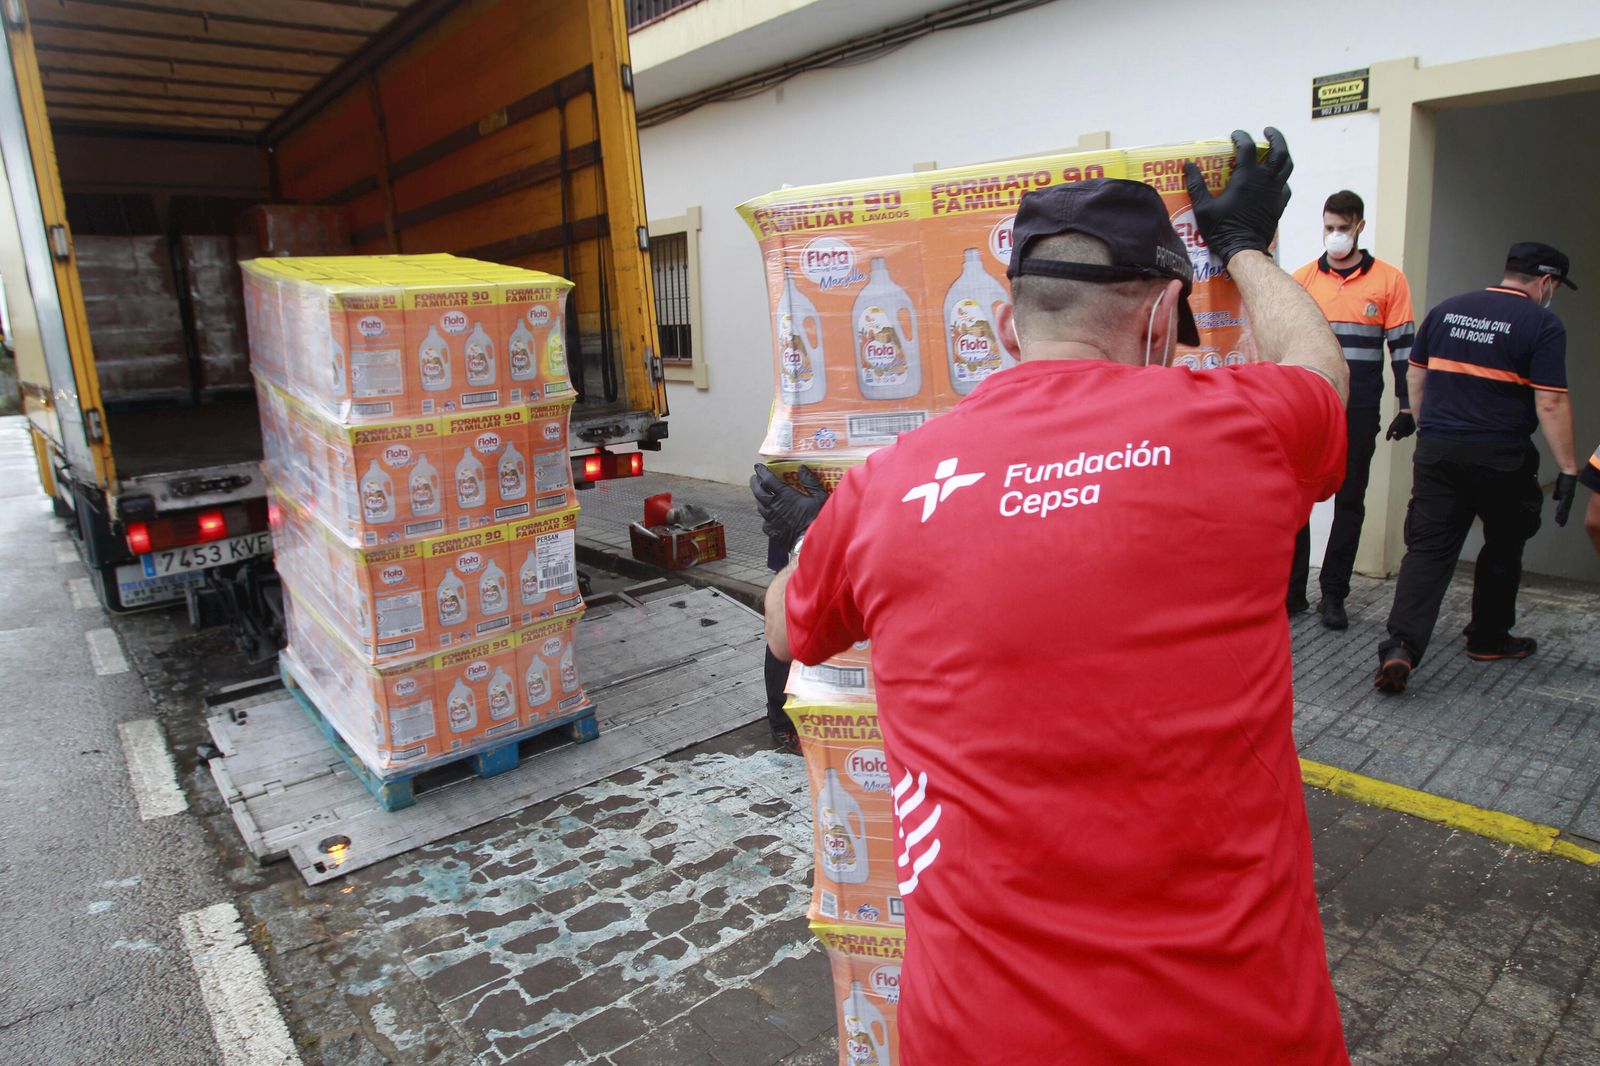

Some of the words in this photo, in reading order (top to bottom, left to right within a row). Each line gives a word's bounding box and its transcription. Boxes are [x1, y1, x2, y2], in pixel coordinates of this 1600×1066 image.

[1321, 83, 1360, 96] STANLEY
[931, 170, 1051, 199] FORMATO
[753, 196, 854, 223] FORMATO
[864, 190, 902, 212] 90
[932, 188, 1045, 214] FAMILI
[759, 211, 855, 237] FAMILIAR
[862, 210, 910, 222] LAVADOS
[1175, 223, 1208, 248] Flo
[807, 247, 849, 267] Flota
[415, 292, 468, 301] FORMATO
[472, 291, 489, 300] 90
[505, 287, 551, 296] FORMATO
[505, 294, 551, 303] FAMILIAR
[382, 295, 396, 305] 90
[415, 299, 468, 308] FAMILIAR
[444, 316, 465, 325] Flota
[530, 310, 548, 318] Flota
[361, 320, 382, 329] Flota
[1443, 313, 1489, 330] PROTECCIÓN
[1491, 321, 1512, 334] CIVIL
[1450, 327, 1467, 340] SAN
[1466, 328, 1495, 344] ROQUE
[868, 345, 894, 357] Flota
[960, 339, 988, 351] Flota
[450, 415, 501, 427] FORMATO
[504, 412, 521, 421] 90
[355, 426, 412, 437] FORMATO
[415, 423, 434, 433] 90
[451, 423, 501, 433] FAMILIAR
[355, 433, 412, 444] FAMILIAR
[478, 437, 498, 446] Flota
[386, 449, 408, 458] Flota
[1003, 440, 1171, 488] Fundación
[999, 484, 1101, 518] Cepsa
[515, 517, 560, 532] FORMATO
[562, 514, 576, 523] 90
[516, 524, 560, 539] FAMILIAR
[537, 533, 559, 543] PERSAN
[432, 534, 482, 550] FORMATO
[485, 530, 501, 540] 90
[162, 545, 222, 572] 7453
[229, 534, 268, 559] KVF
[432, 541, 482, 556] FAMILIAR
[459, 555, 479, 566] Flota
[383, 569, 403, 578] Flota
[441, 645, 490, 661] FORMATO
[493, 639, 509, 649] 90
[441, 651, 489, 667] FAMILIAR
[468, 665, 488, 675] Flota
[396, 681, 414, 690] Flota
[798, 714, 879, 728] FORMAT
[803, 725, 883, 740] FAMILIA
[825, 932, 906, 947] FORMAT
[830, 940, 904, 959] FAMILIA
[876, 973, 901, 988] Flo
